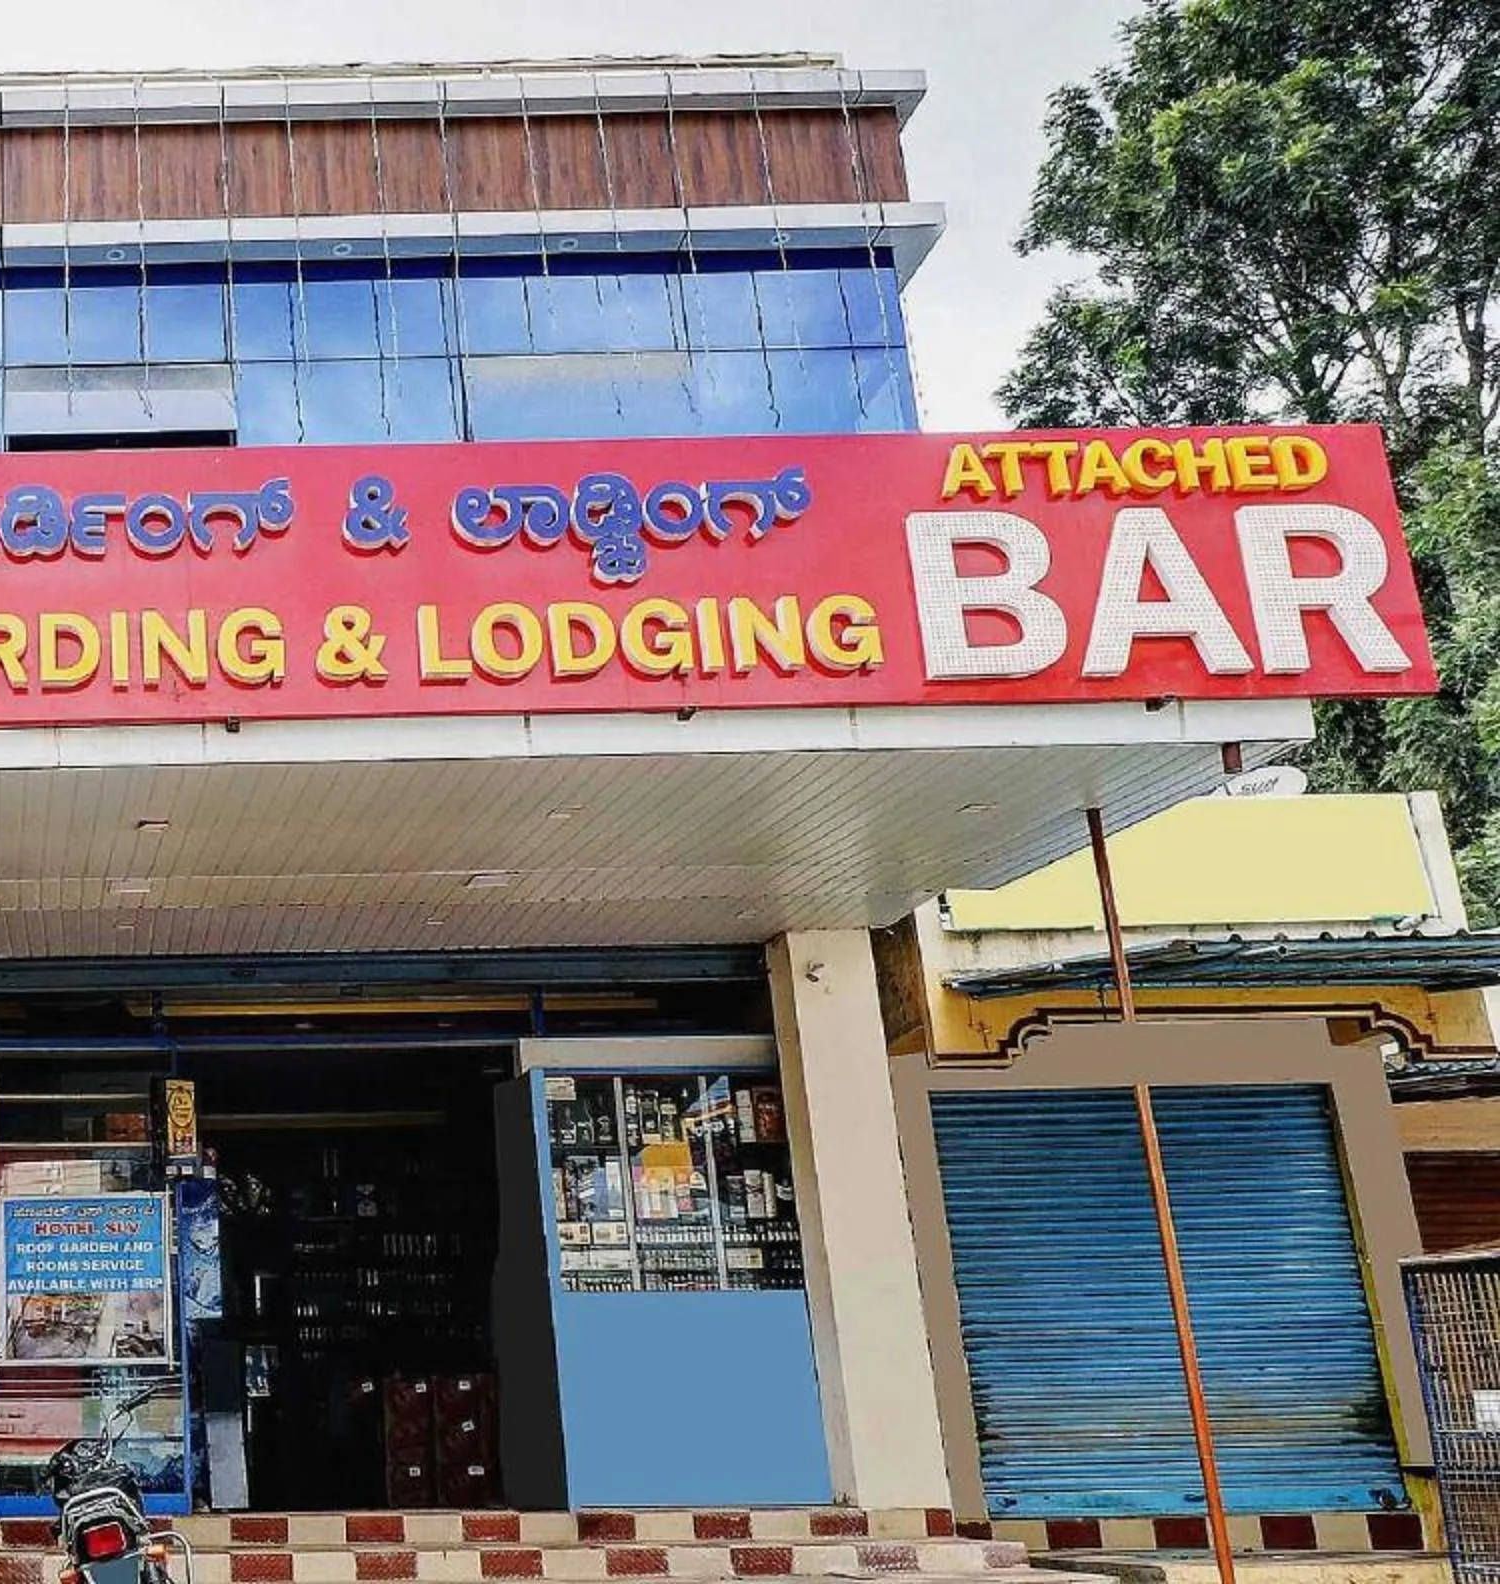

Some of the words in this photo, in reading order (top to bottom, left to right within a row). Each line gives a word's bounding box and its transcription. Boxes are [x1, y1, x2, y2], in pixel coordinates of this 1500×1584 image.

[941, 435, 1328, 497] ATTACHED
[341, 474, 410, 550] &
[905, 503, 1412, 680] BAR
[315, 604, 389, 681] &
[417, 595, 885, 680] LODGING
[35, 1221, 98, 1236] HOTEL
[105, 1221, 140, 1236] SLV
[16, 1243, 54, 1254] ROOF
[60, 1242, 119, 1253] GARDEN
[124, 1242, 153, 1252] AND
[26, 1261, 79, 1272] ROOMS
[82, 1260, 145, 1271] SERVICE
[8, 1280, 87, 1291] AVAILABLE
[90, 1279, 128, 1290] WITH
